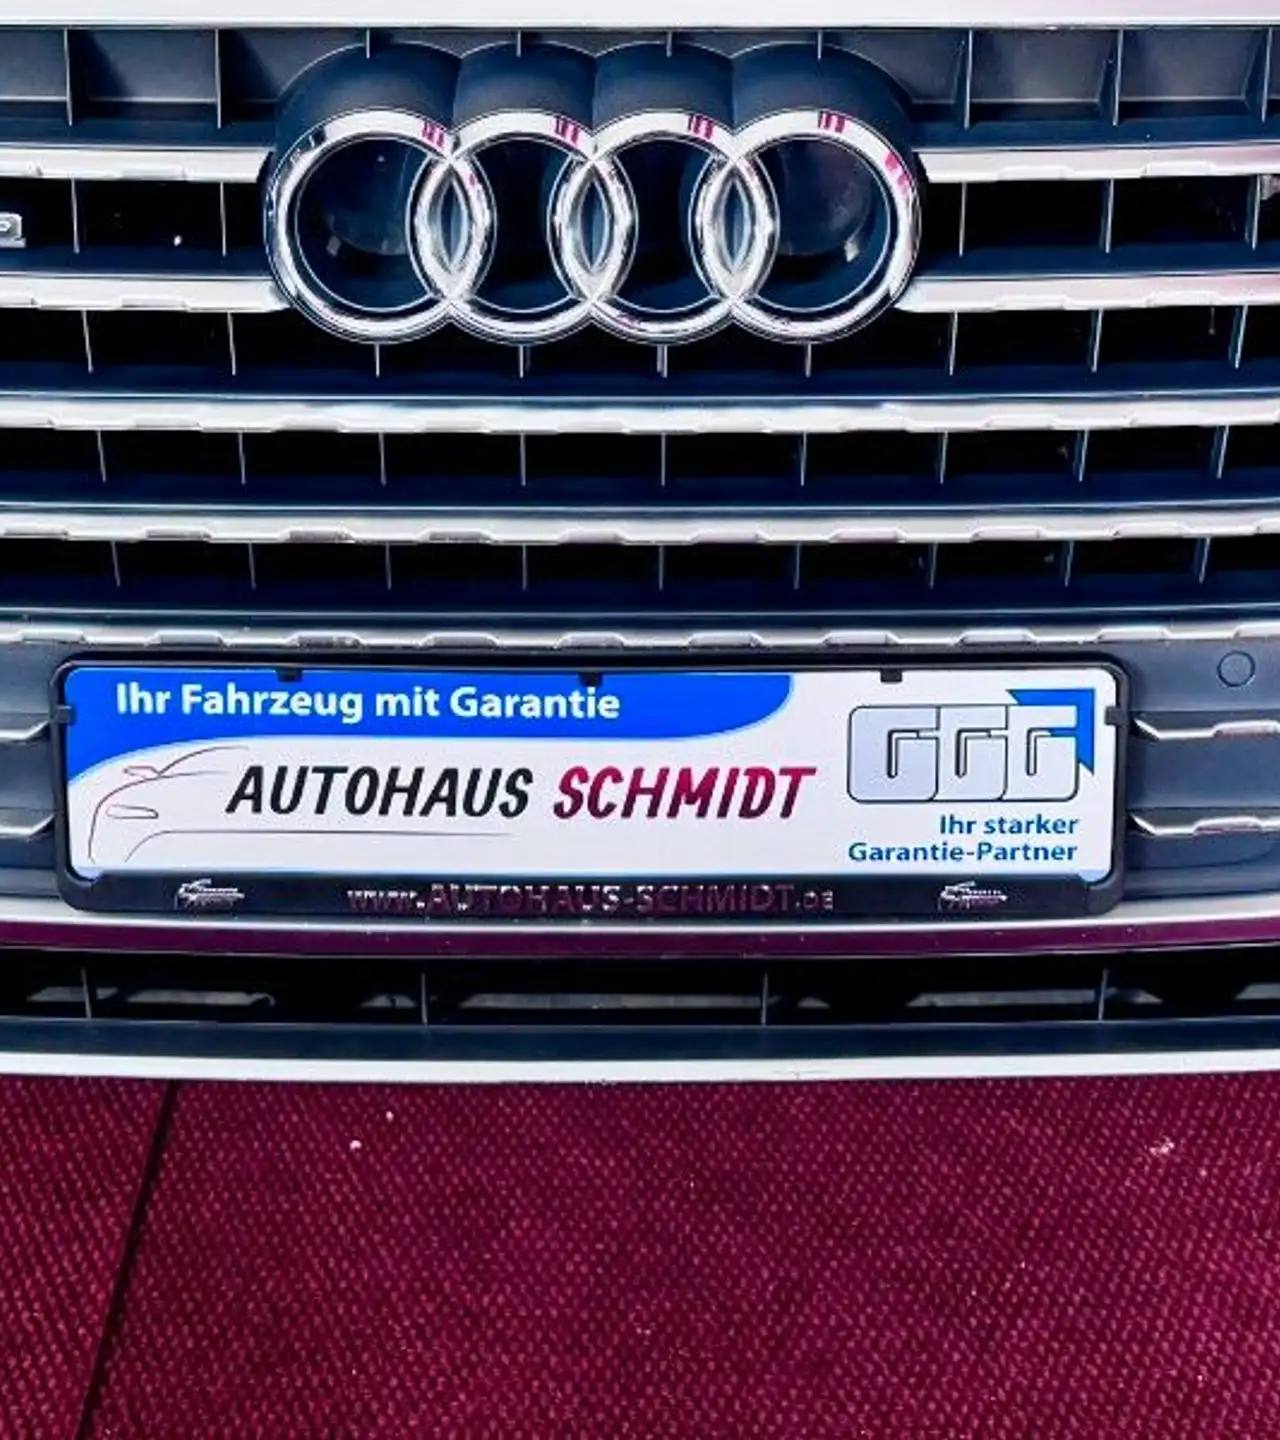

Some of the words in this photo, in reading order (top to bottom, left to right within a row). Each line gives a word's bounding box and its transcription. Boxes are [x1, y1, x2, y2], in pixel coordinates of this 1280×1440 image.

[116, 683, 170, 714] Ihr
[181, 683, 364, 724] Fahrzeug
[375, 686, 439, 717] mit
[450, 686, 620, 720] Garantie
[847, 702, 1082, 804] GGG
[226, 765, 533, 818] AUTOHAUS
[553, 766, 816, 820] SCHMIDT
[940, 814, 976, 835] Ihr
[984, 813, 1080, 835] starker
[848, 842, 1077, 862] Garantie-Partner
